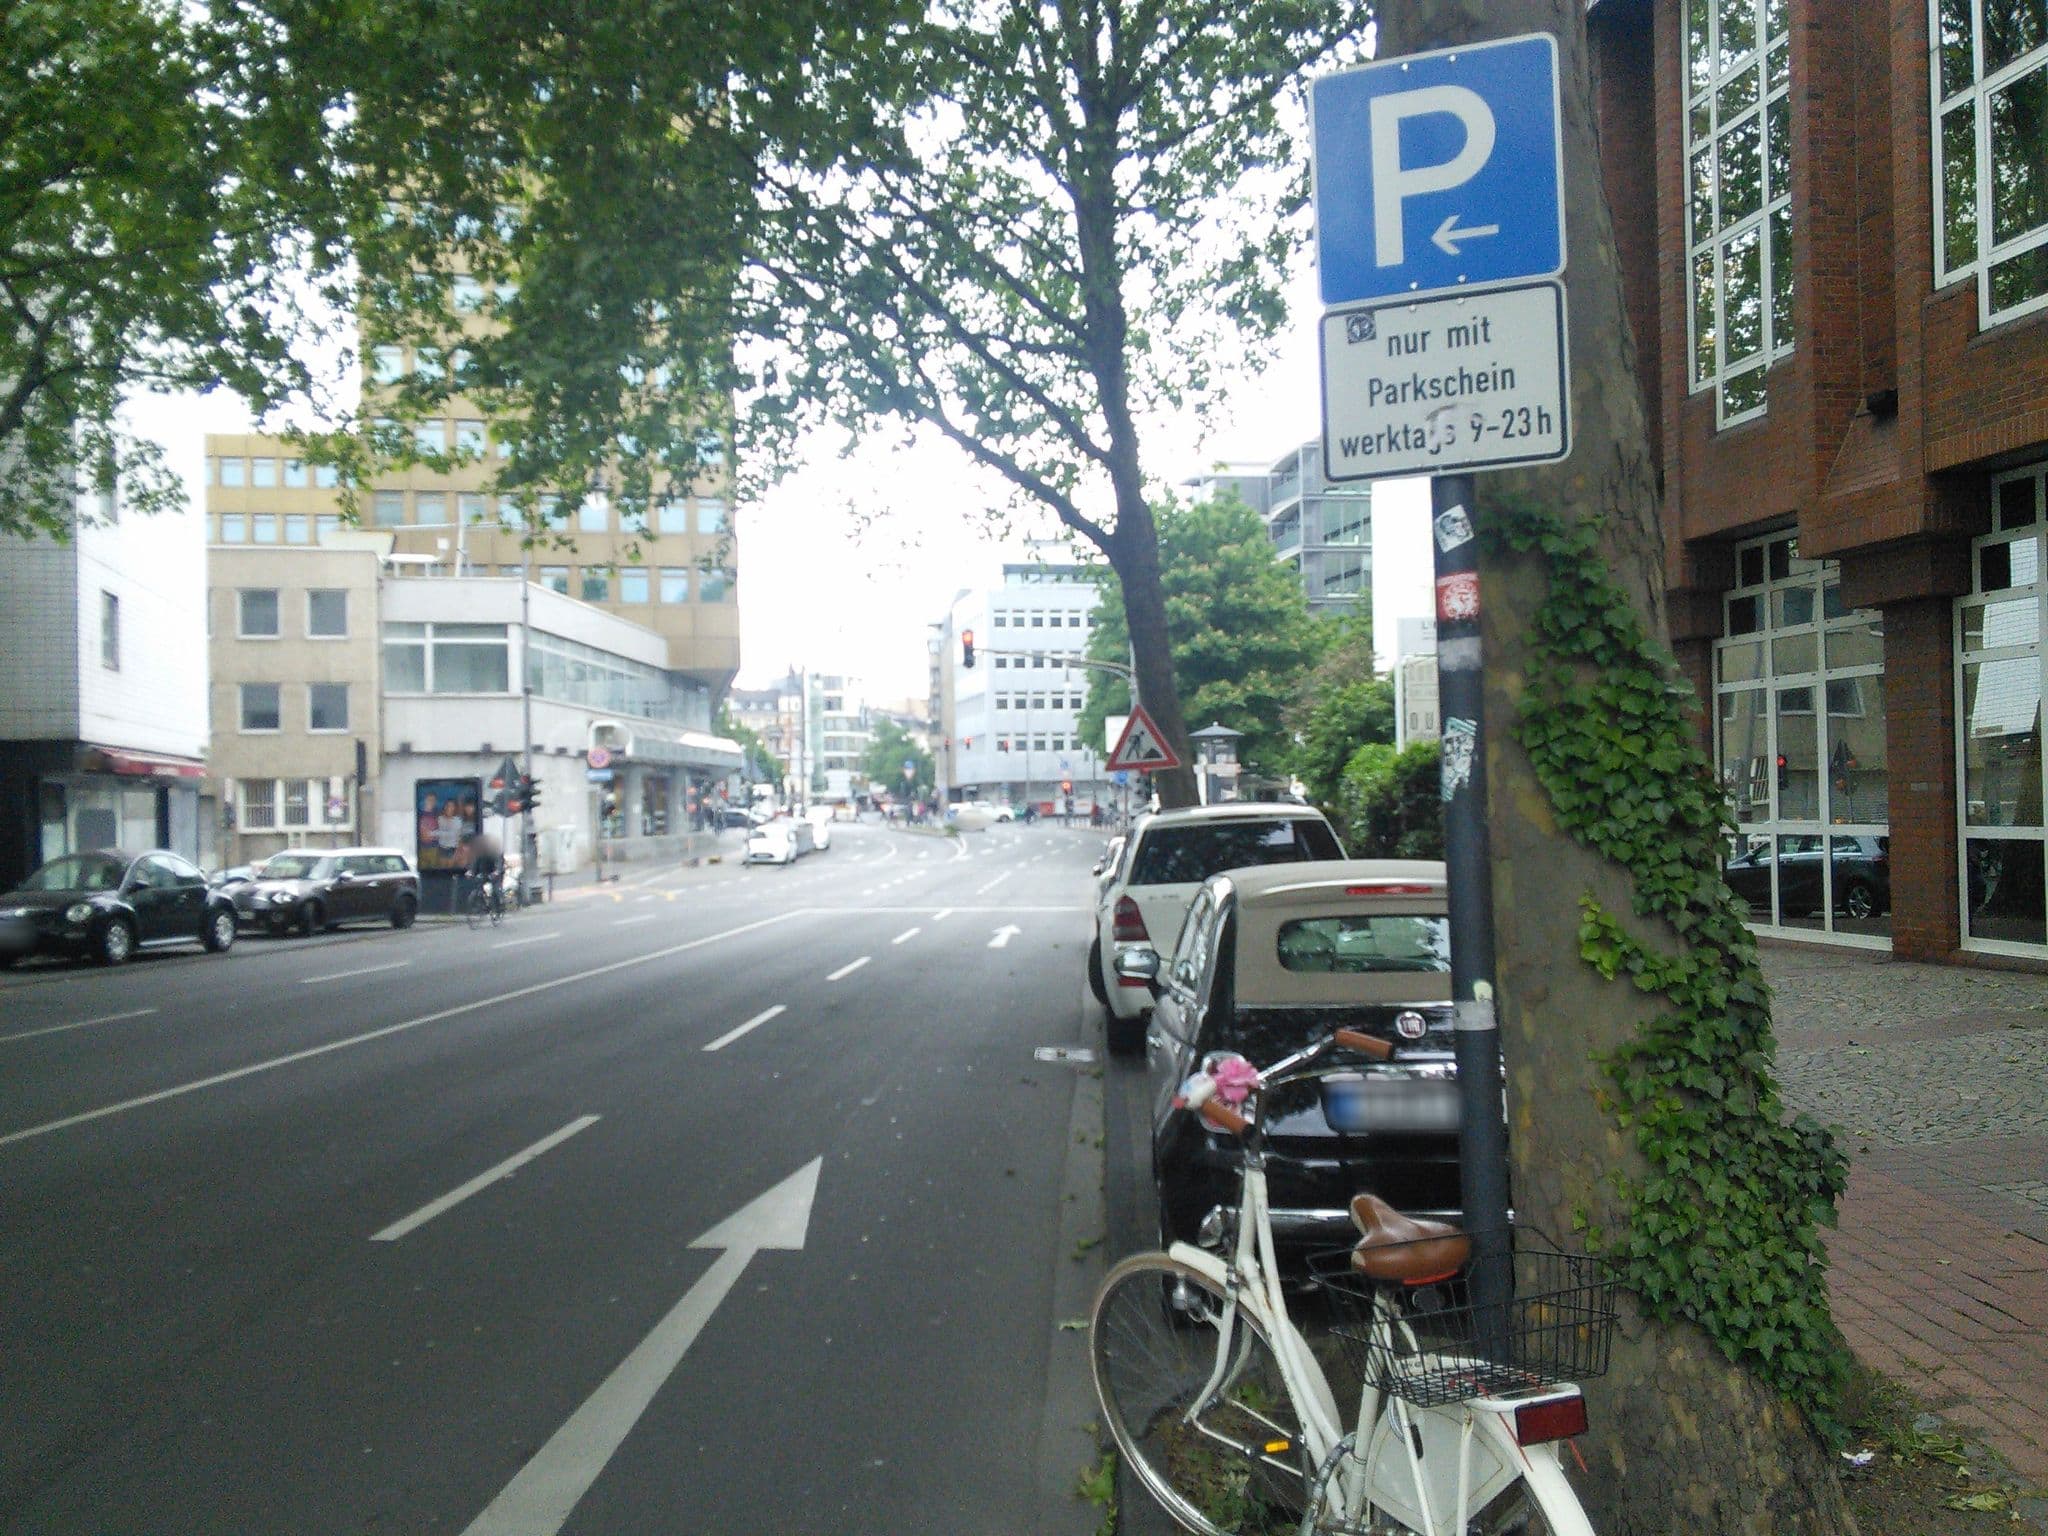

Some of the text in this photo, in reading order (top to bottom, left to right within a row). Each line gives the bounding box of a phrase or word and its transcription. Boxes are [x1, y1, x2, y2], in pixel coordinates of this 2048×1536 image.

[1369, 85, 1496, 268] P
[1387, 316, 1491, 357] nur mit
[1368, 362, 1516, 407] Parkschein
